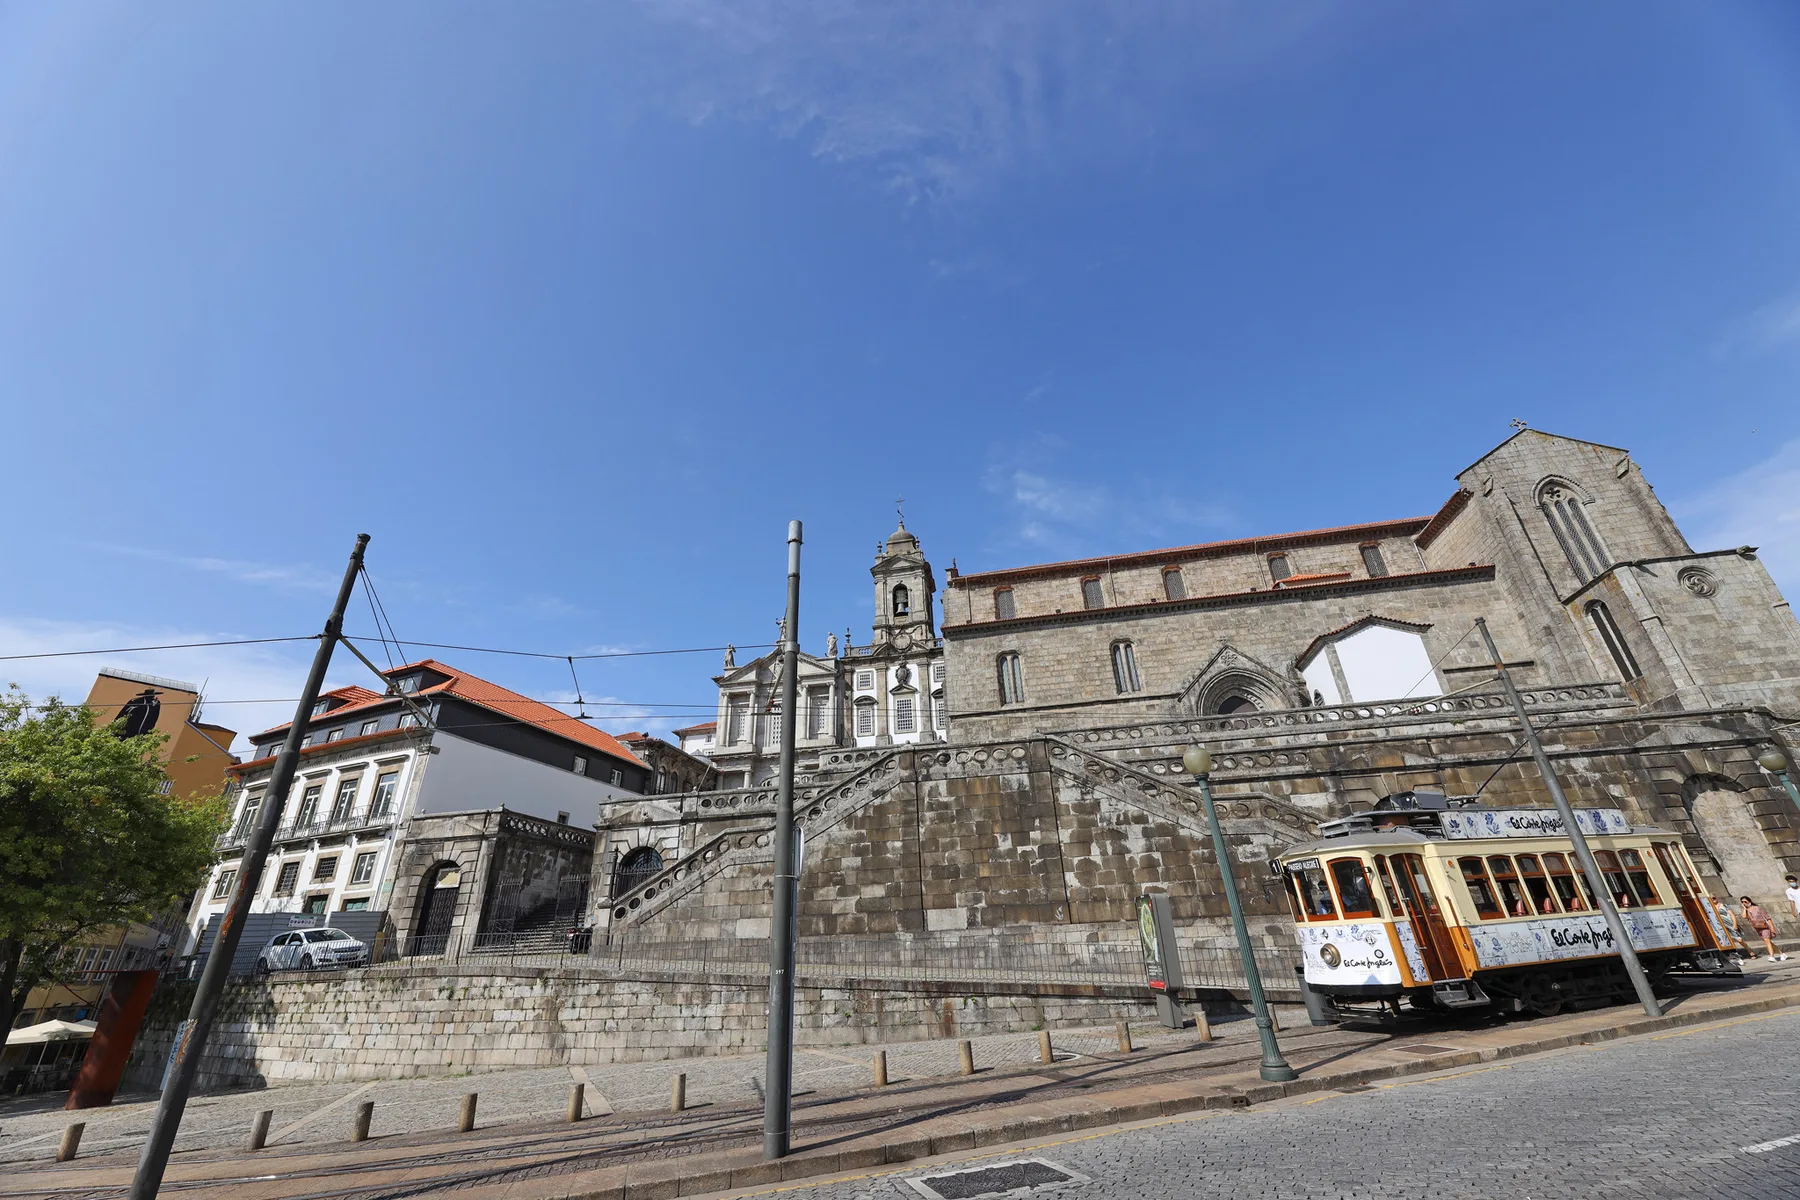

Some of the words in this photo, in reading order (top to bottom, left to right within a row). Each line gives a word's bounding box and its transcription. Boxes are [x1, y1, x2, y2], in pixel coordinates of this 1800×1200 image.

[1510, 816, 1522, 829] El
[1520, 816, 1541, 829] Corte
[1537, 813, 1565, 833] Inglé
[1550, 928, 1566, 947] El
[1563, 928, 1591, 945] Corte
[1586, 921, 1615, 949] Ingl
[1343, 959, 1350, 968] El
[1350, 959, 1367, 967] Corte
